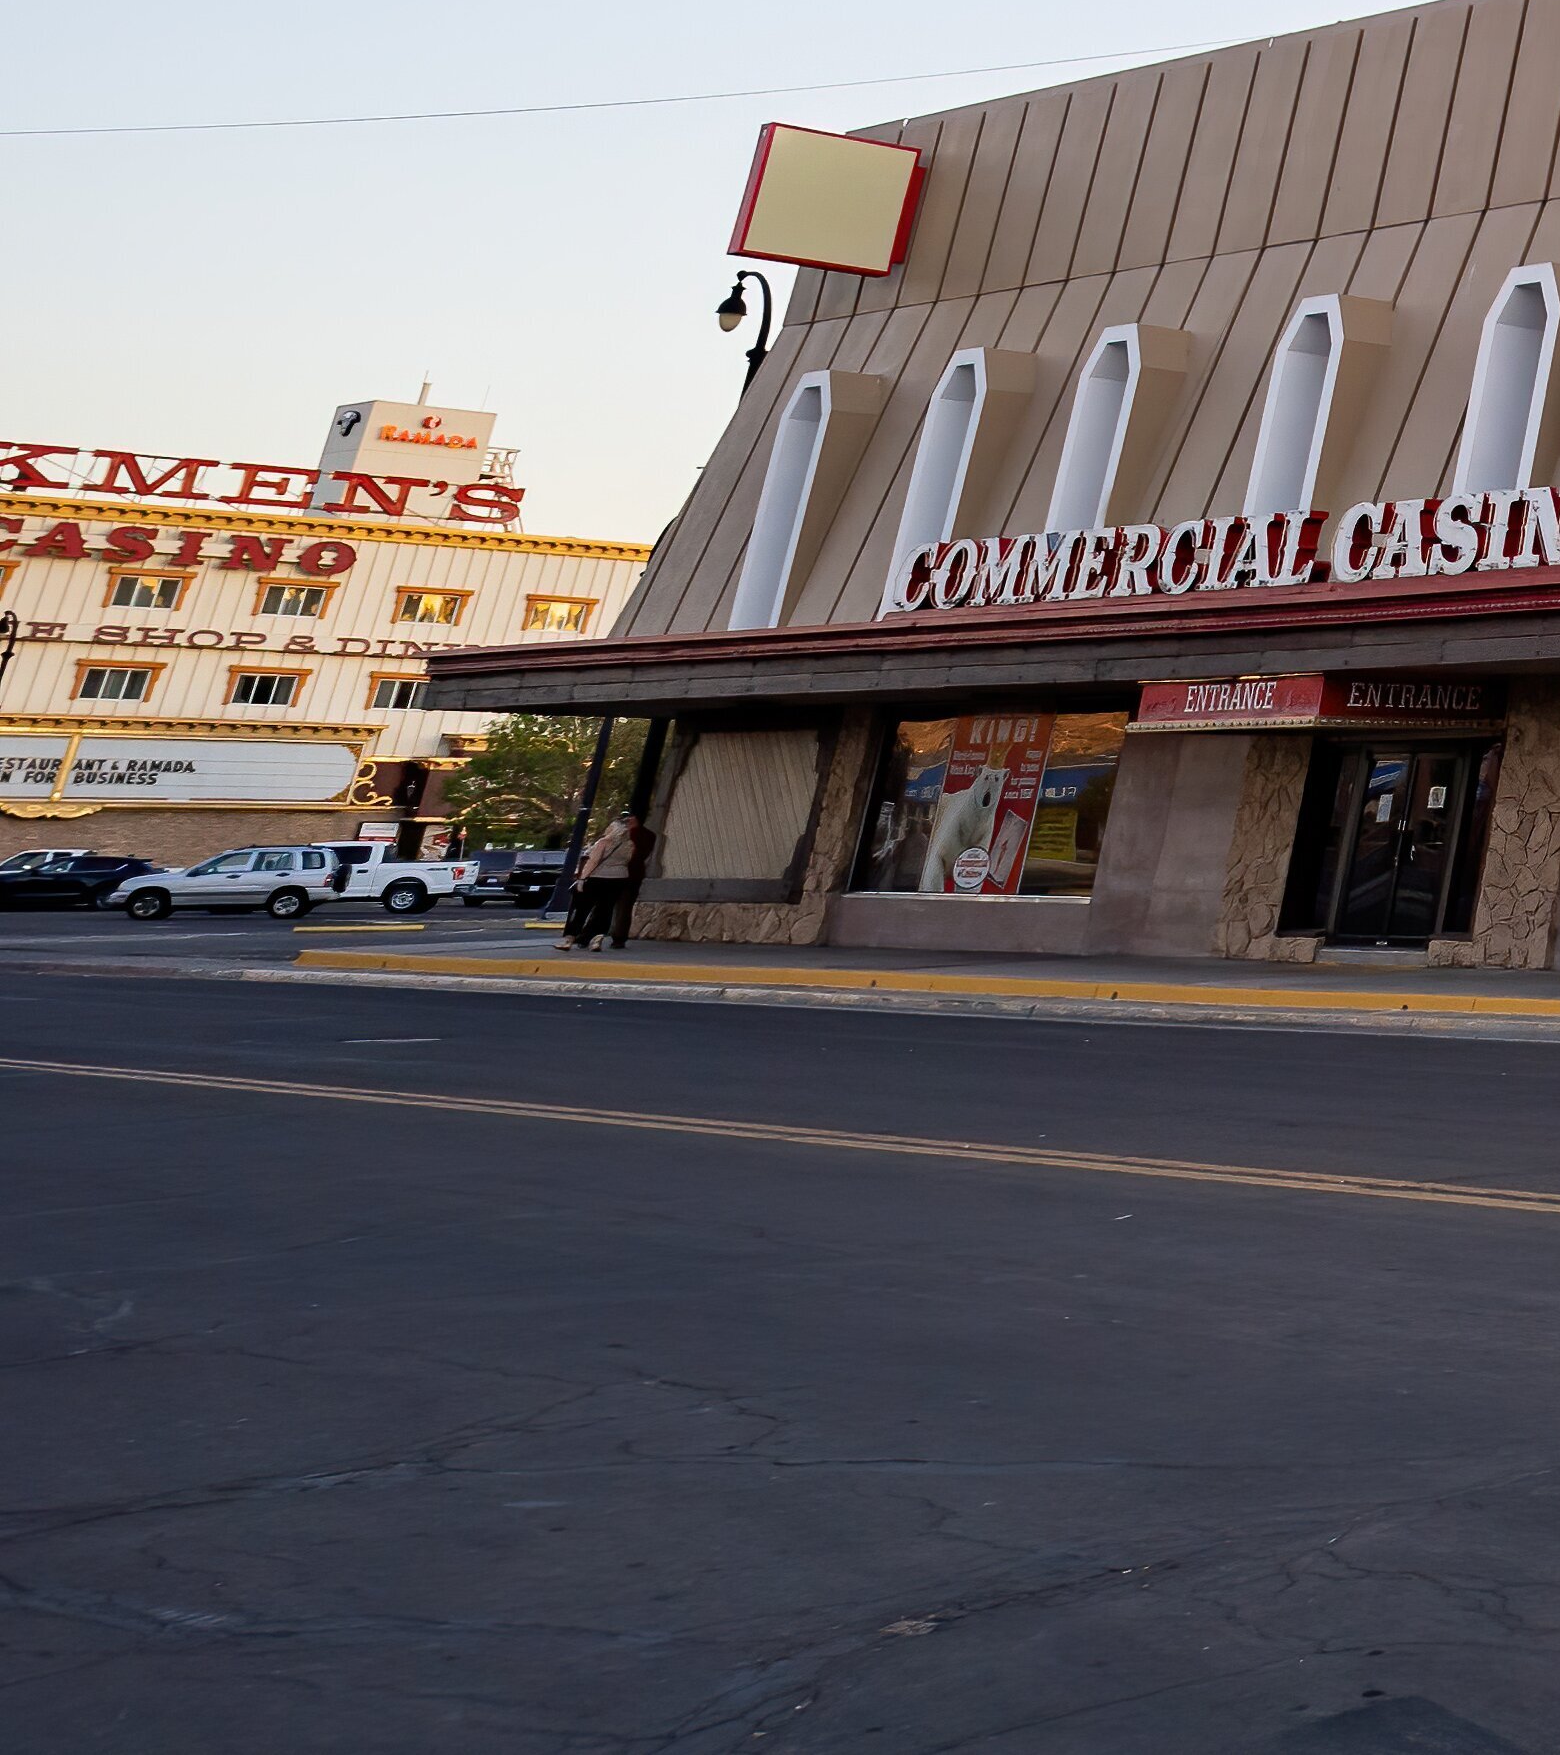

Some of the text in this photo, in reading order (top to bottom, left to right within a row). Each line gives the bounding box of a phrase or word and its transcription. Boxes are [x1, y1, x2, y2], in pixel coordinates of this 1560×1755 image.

[378, 423, 478, 450] RAMADA
[892, 509, 1324, 612] COMMERCIAL
[92, 624, 267, 649] SHOP
[283, 635, 318, 654] &
[1183, 681, 1277, 713] ENTRANCE
[1346, 682, 1482, 711] ENTRANCE
[969, 718, 1039, 744] KING!
[23, 770, 57, 784] FOR
[73, 771, 159, 786] BUSINESS
